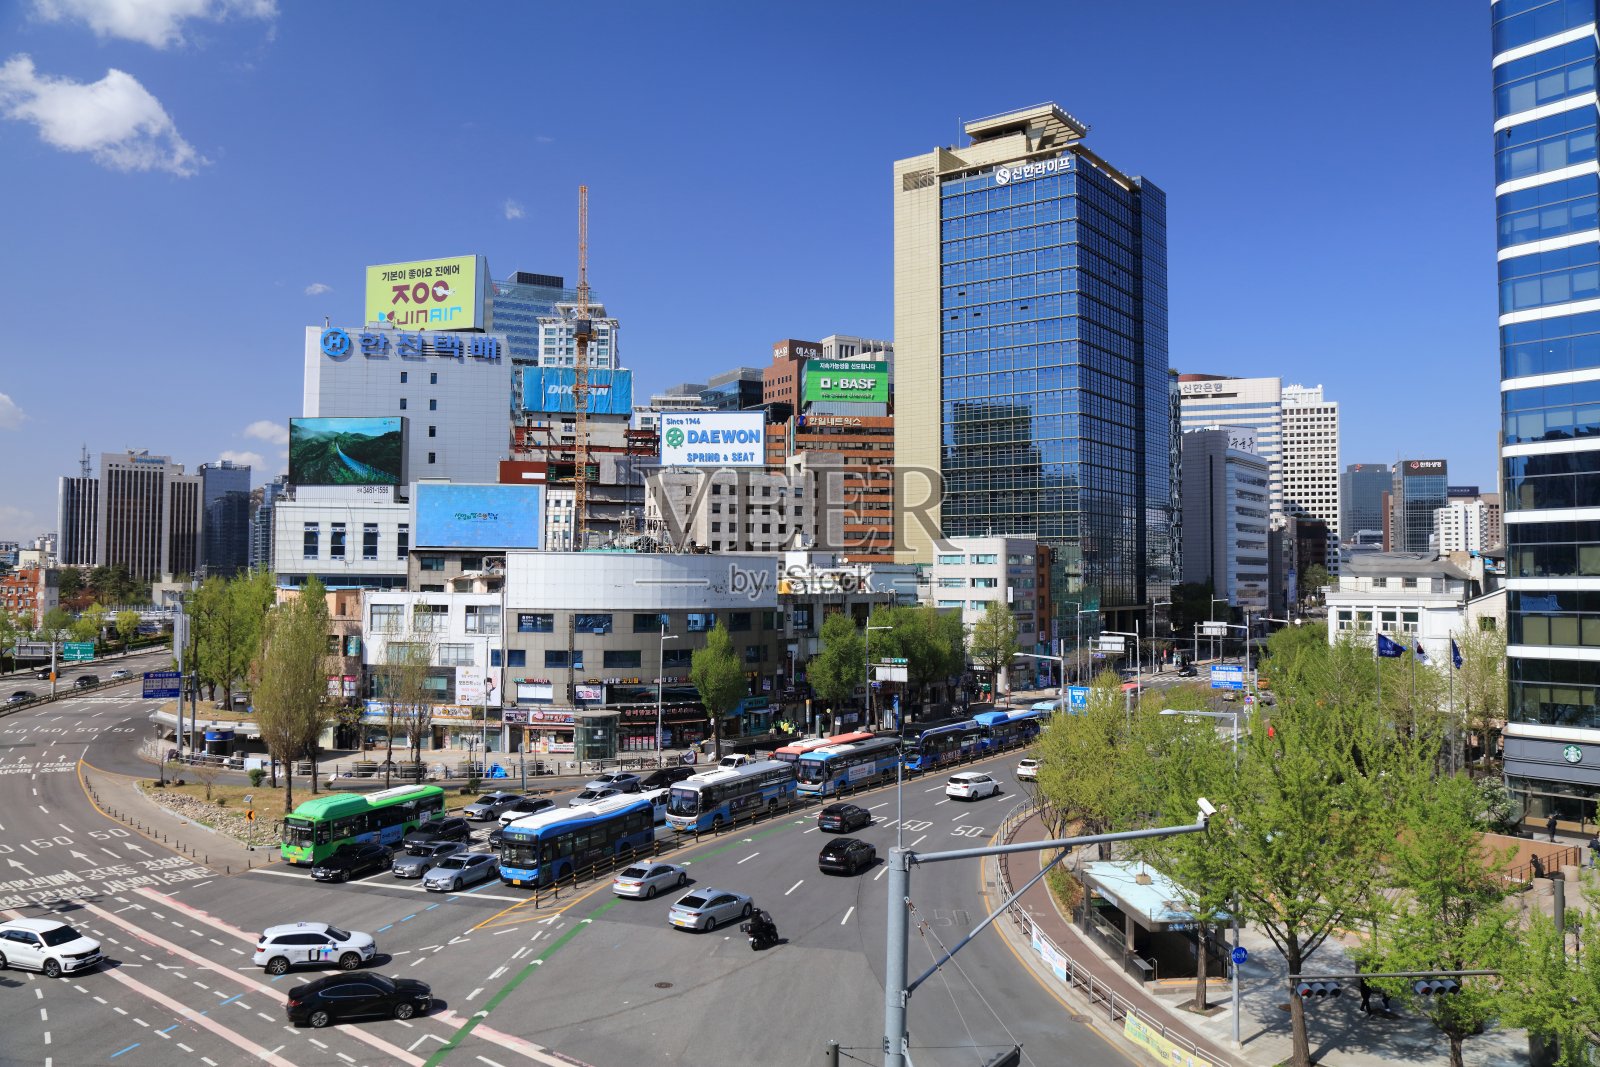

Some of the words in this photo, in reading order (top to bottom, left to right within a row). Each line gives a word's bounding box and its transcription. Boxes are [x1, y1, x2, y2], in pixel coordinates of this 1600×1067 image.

[1011, 157, 1071, 180] 신한라이프
[382, 269, 406, 281] 기본이
[408, 267, 433, 279] 좋아요
[435, 264, 460, 276] 진에어
[358, 332, 497, 359] 한진택배
[840, 378, 877, 390] BASF
[1183, 382, 1223, 394] 신한은행
[666, 417, 684, 425] Since
[687, 429, 761, 444] DAEWON
[687, 452, 721, 463] SPRING
[731, 452, 755, 462] SEAT
[896, 819, 934, 832] 50
[950, 824, 985, 838] 50
[88, 828, 131, 841] 50
[31, 836, 75, 849] 50
